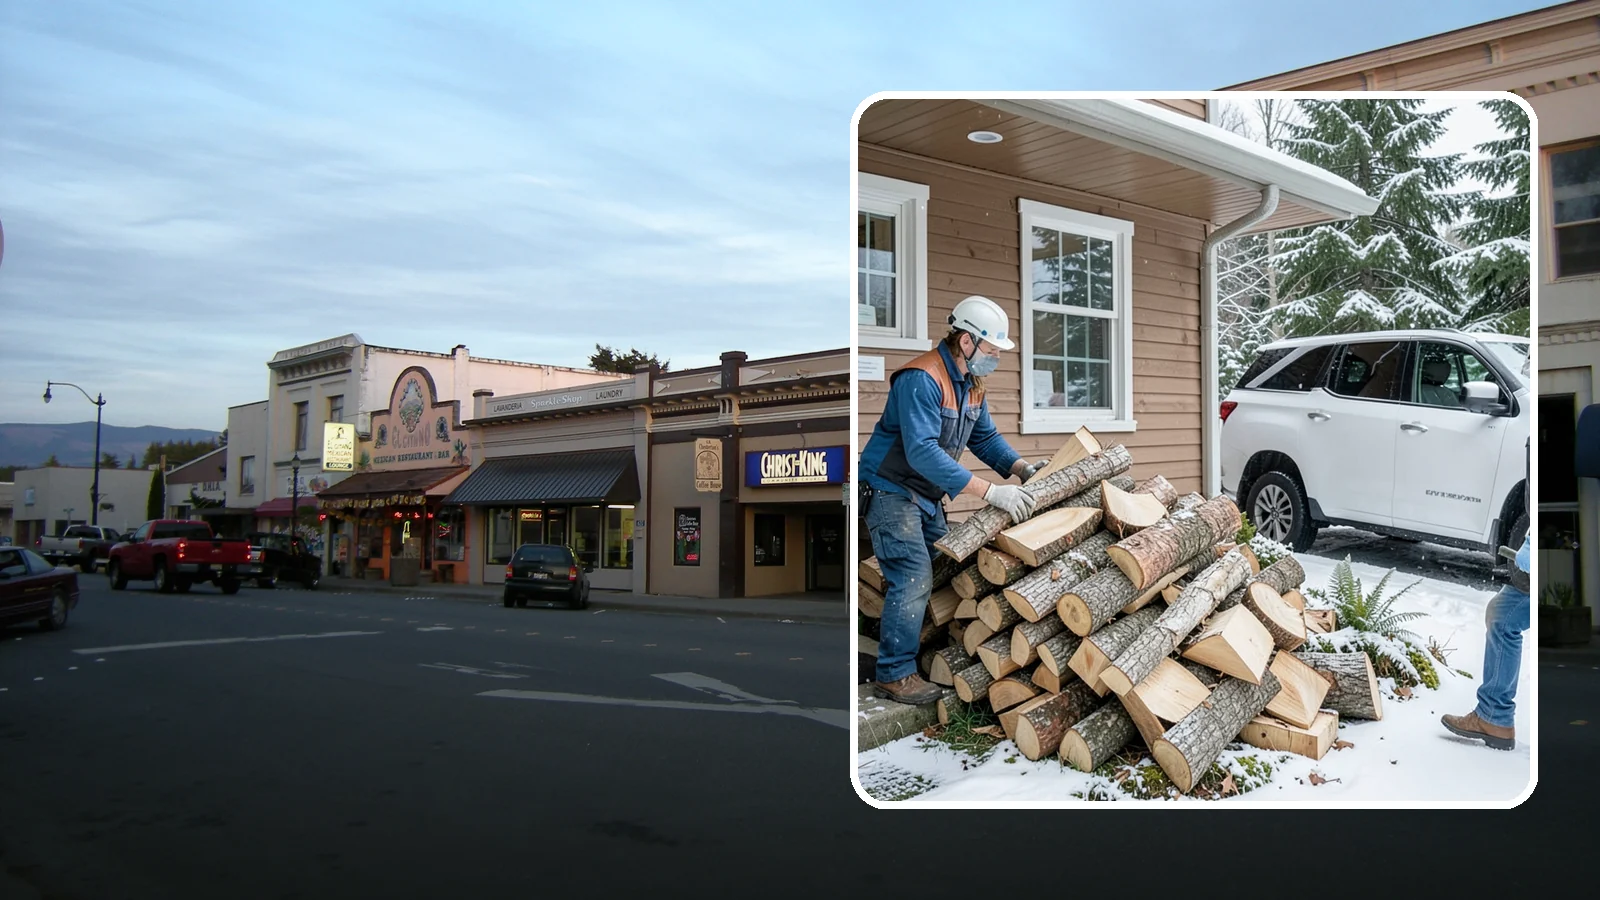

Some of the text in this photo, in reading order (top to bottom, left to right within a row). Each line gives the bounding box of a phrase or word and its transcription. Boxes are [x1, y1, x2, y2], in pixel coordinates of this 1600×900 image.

[530, 394, 582, 408] Sparkle Shop
[595, 389, 623, 399] LAUNDRY
[493, 402, 522, 412] LAVANDERIA
[374, 454, 396, 464] MEXICAN
[398, 452, 433, 462] RESTAURANT
[438, 450, 450, 458] BAR
[761, 452, 797, 478] CHRIST
[799, 450, 827, 476] KING
